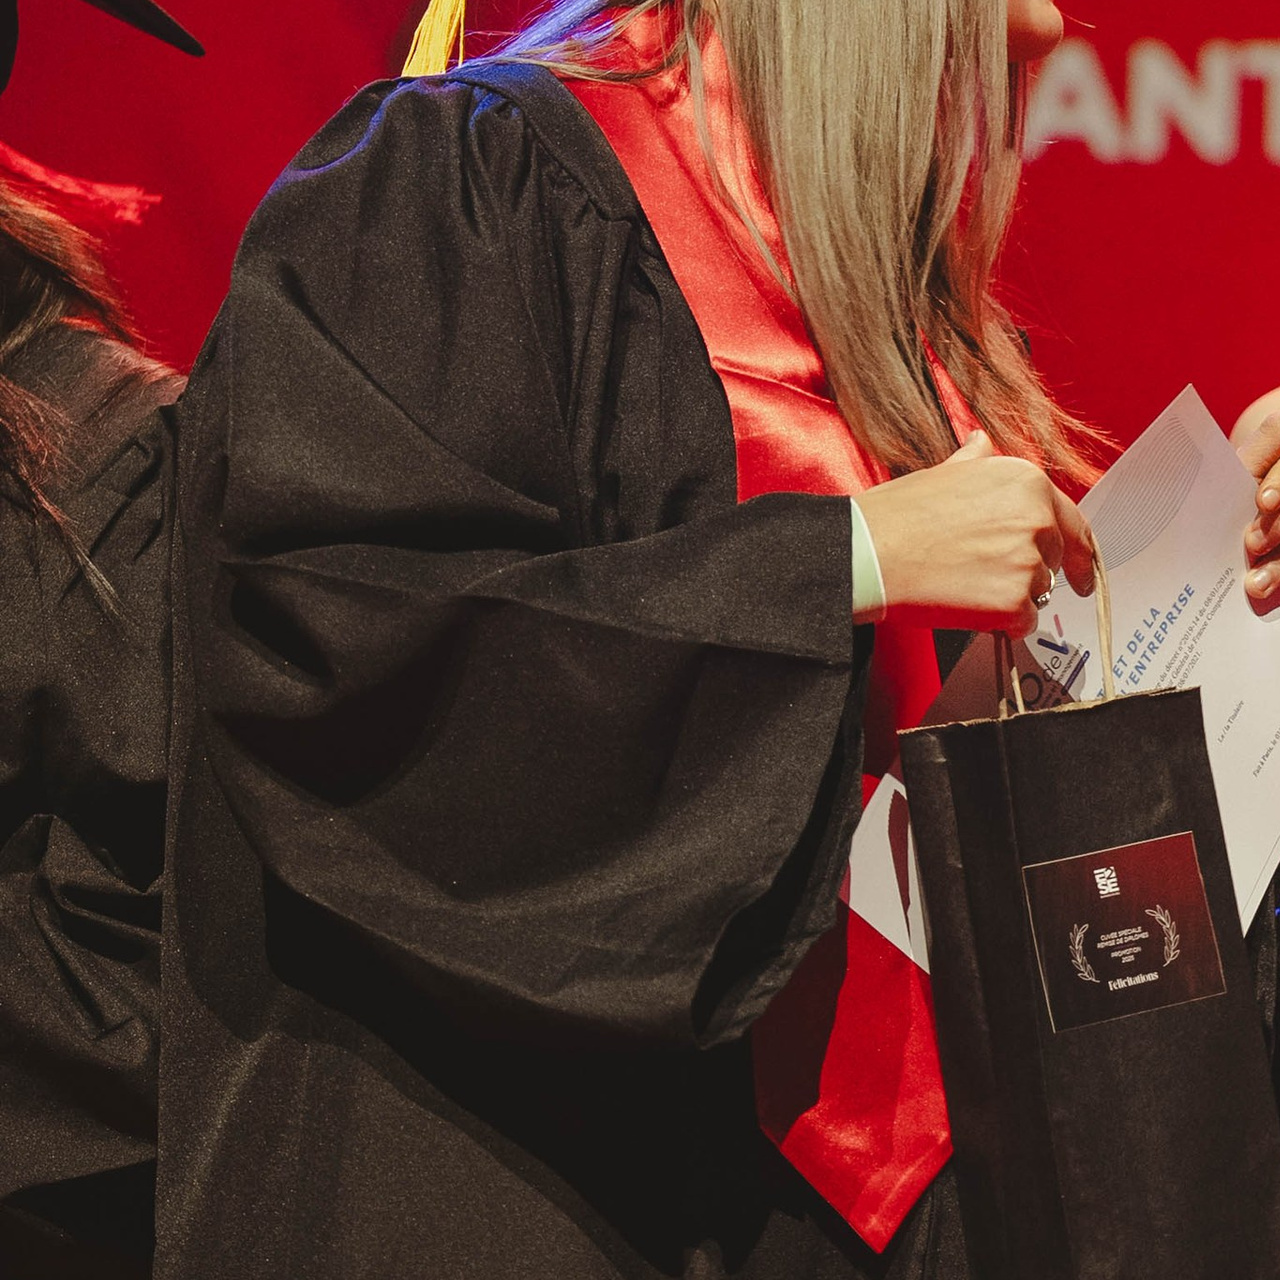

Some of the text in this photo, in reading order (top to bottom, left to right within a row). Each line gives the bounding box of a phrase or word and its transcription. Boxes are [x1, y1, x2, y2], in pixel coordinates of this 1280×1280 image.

[1110, 607, 1160, 678] ET DE LA
[1159, 671, 1167, 682] du
[1164, 650, 1179, 672] décret
[1198, 606, 1206, 617] du
[1171, 577, 1235, 679] Général de France Compétences
